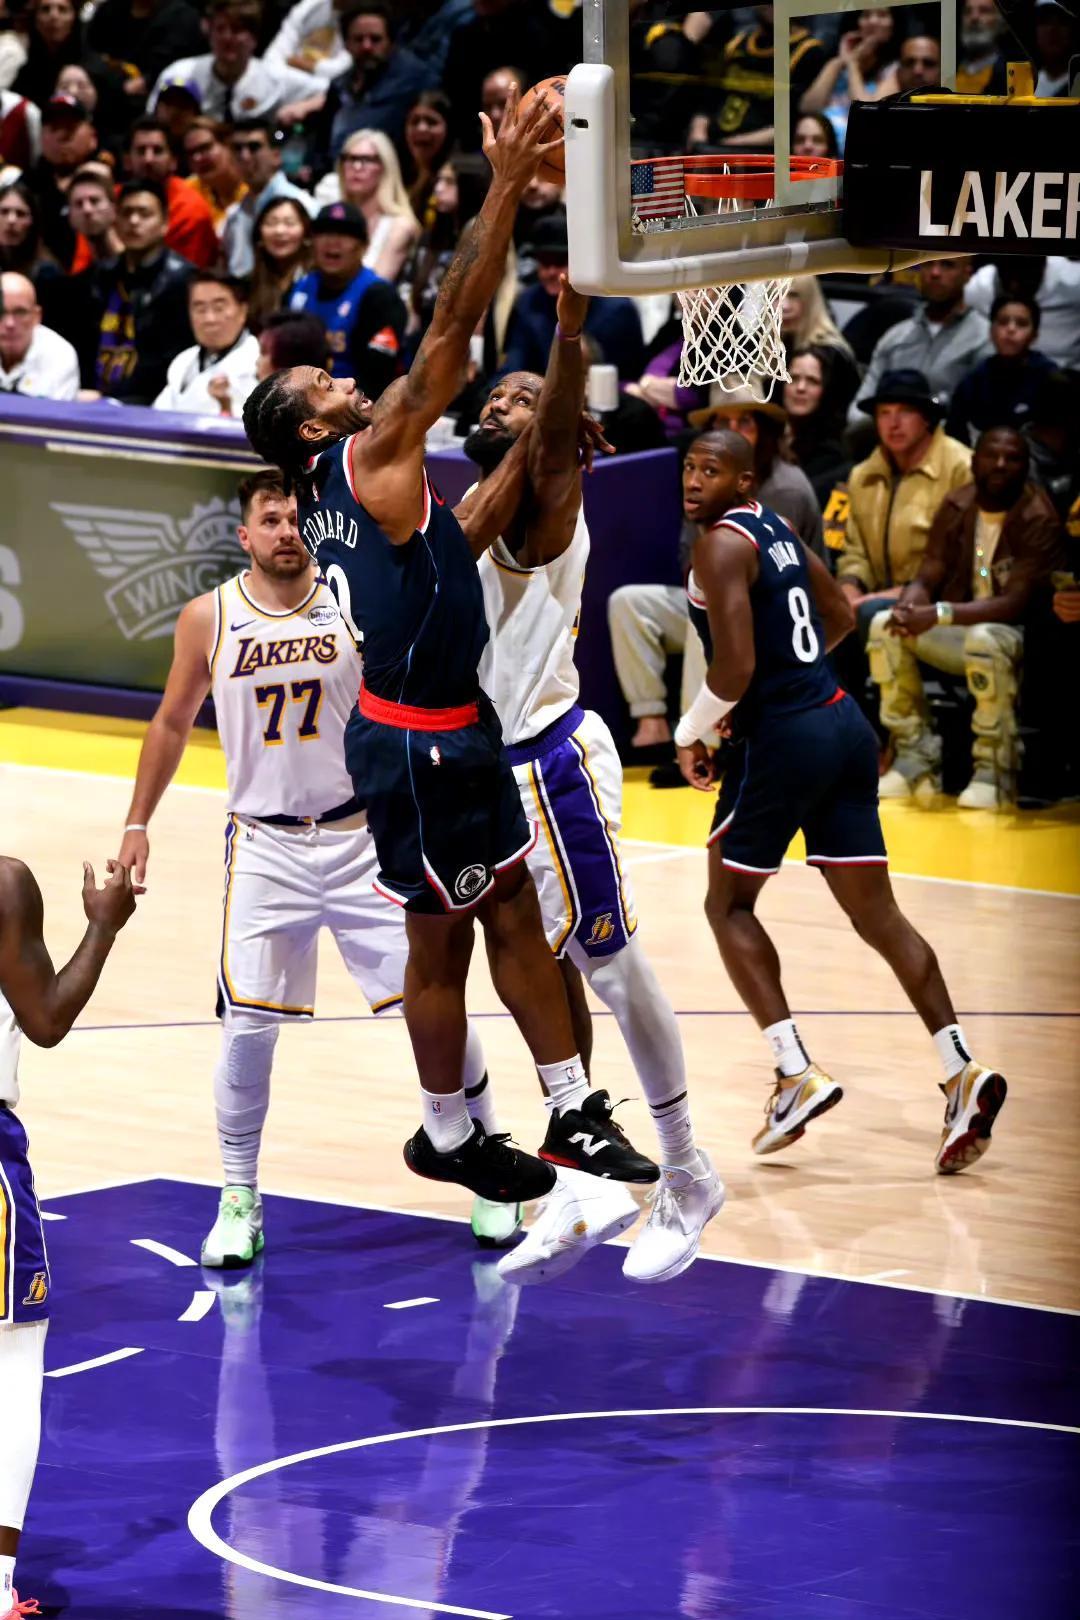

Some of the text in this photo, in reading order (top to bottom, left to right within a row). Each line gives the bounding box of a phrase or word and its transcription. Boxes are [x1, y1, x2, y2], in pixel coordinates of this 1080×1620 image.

[303, 508, 358, 563] EONARD
[123, 562, 231, 618] WING
[788, 586, 819, 663] 8
[229, 634, 339, 679] LAKERS
[254, 678, 324, 747] 77
